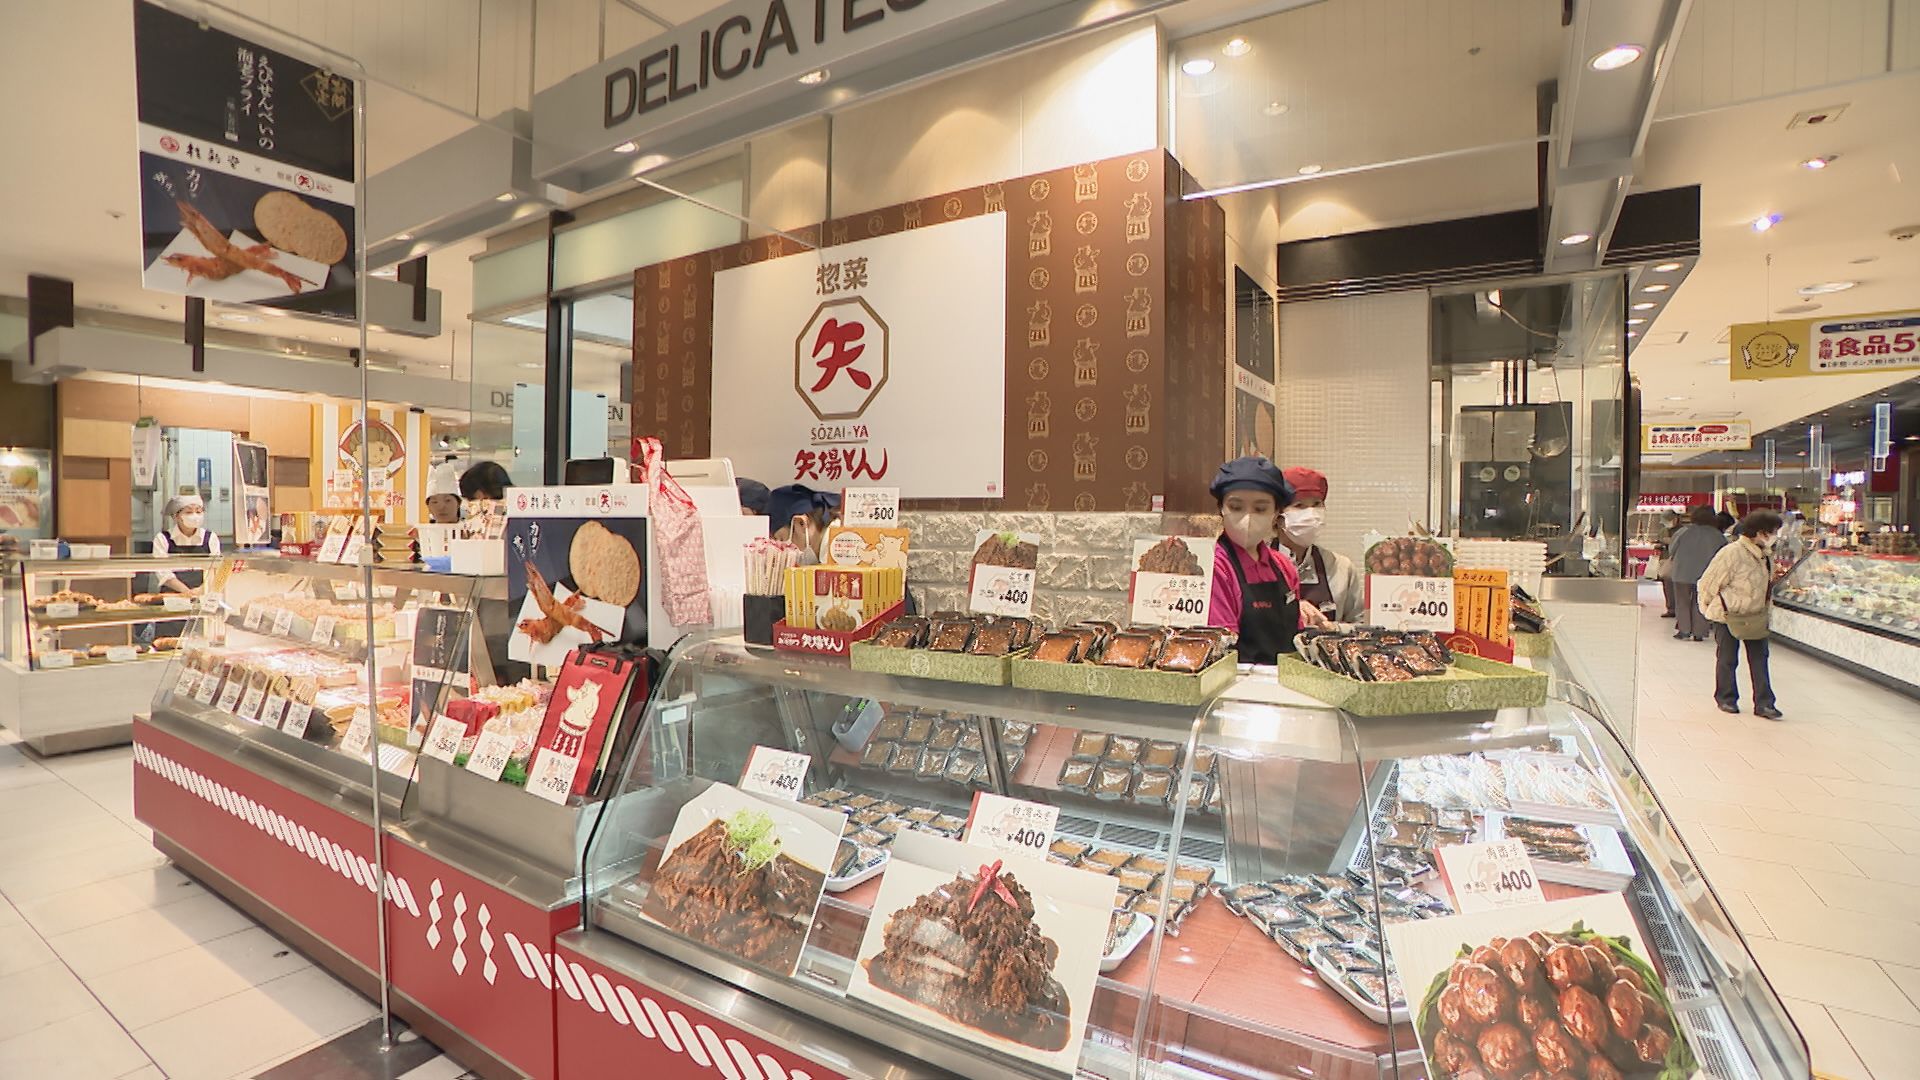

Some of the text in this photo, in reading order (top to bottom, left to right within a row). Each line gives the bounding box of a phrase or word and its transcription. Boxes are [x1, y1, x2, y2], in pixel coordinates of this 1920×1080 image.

[603, 0, 930, 129] DELICATE
[258, 55, 275, 150] えびせんべいの
[816, 257, 868, 295] 惣菜
[811, 317, 872, 392] 矢
[1835, 332, 1920, 358] 食品5
[794, 447, 889, 481] 矢場とん
[999, 589, 1028, 604] ¥400
[1168, 598, 1204, 614] ¥400
[1409, 601, 1449, 617] ¥400
[801, 632, 844, 652] 矢場とん
[1007, 828, 1046, 849] ¥400
[1493, 869, 1532, 893] ¥400
